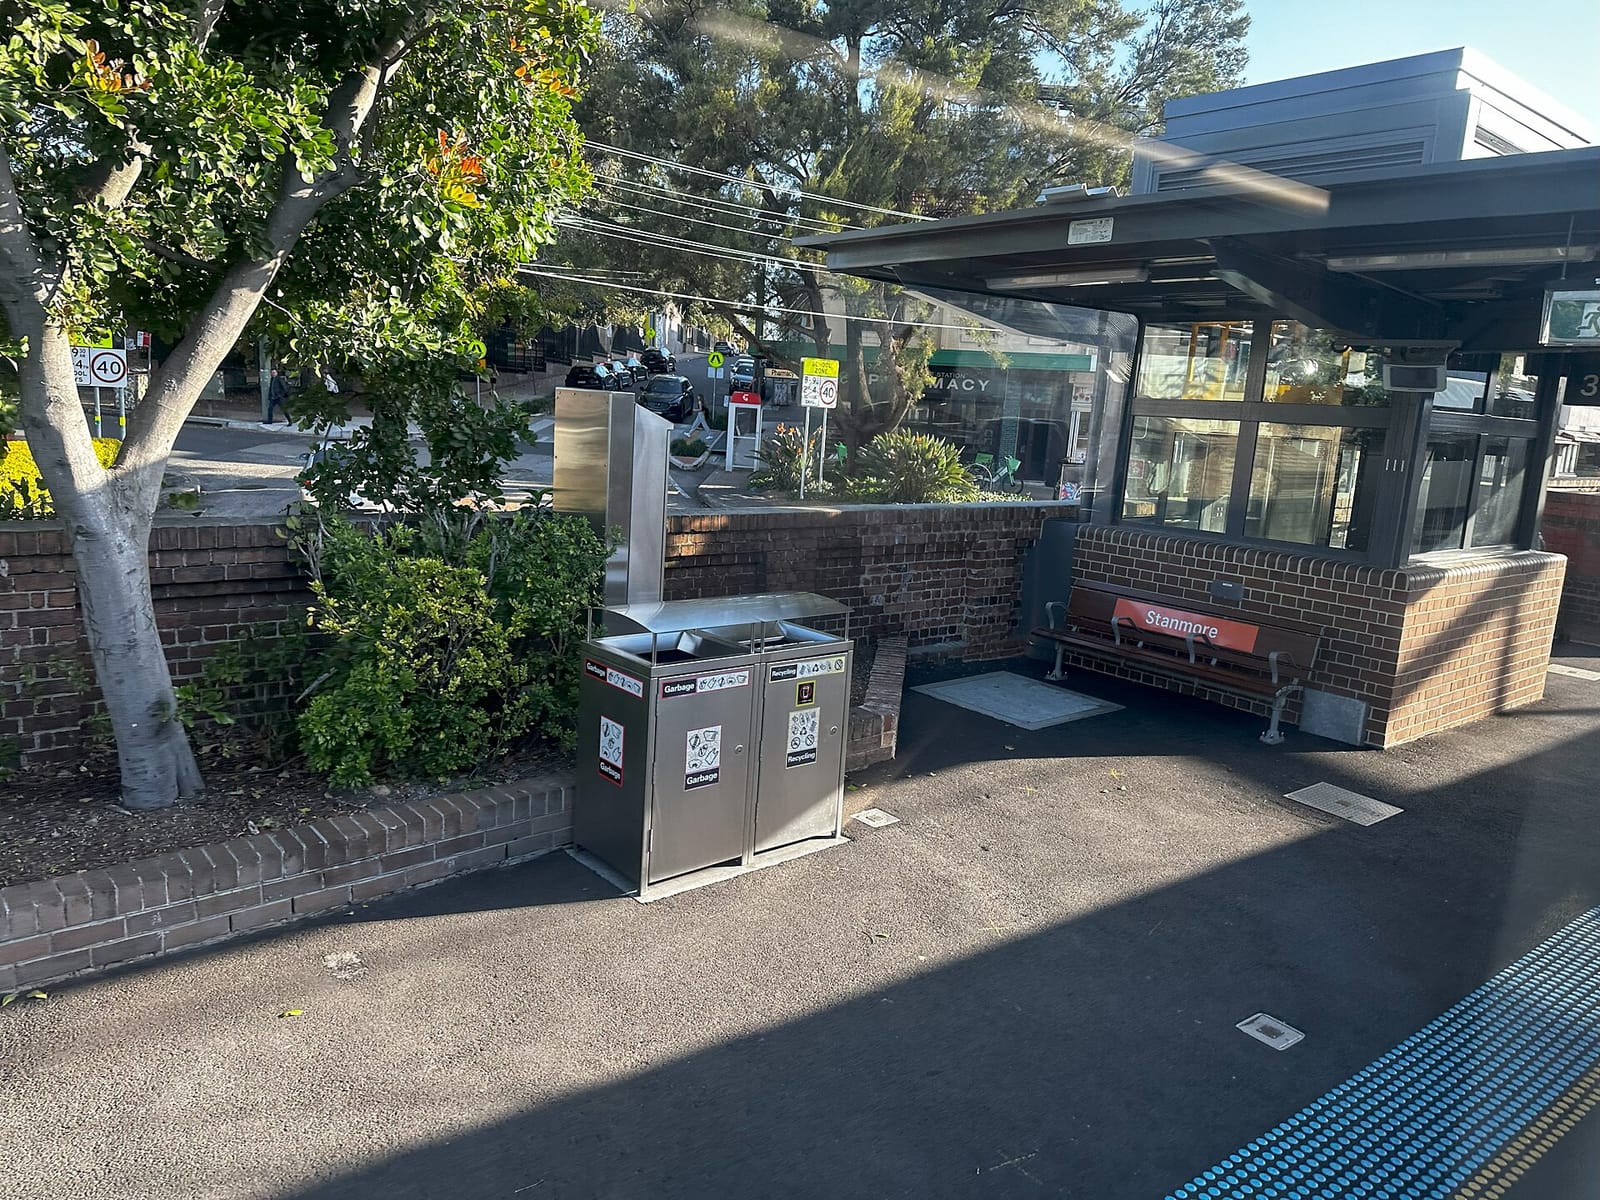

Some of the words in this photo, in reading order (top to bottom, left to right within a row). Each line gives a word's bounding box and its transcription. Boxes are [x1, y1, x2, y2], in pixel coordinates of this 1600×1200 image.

[96, 361, 121, 375] 40
[1580, 374, 1600, 397] 3
[822, 386, 834, 399] 40
[1145, 610, 1218, 638] Stanmore
[586, 662, 606, 677] Garbage
[771, 668, 796, 677] Recycling
[664, 682, 695, 694] Garbage
[787, 751, 816, 763] Recycling
[600, 761, 621, 780] Garbage
[686, 772, 718, 785] Garbage
